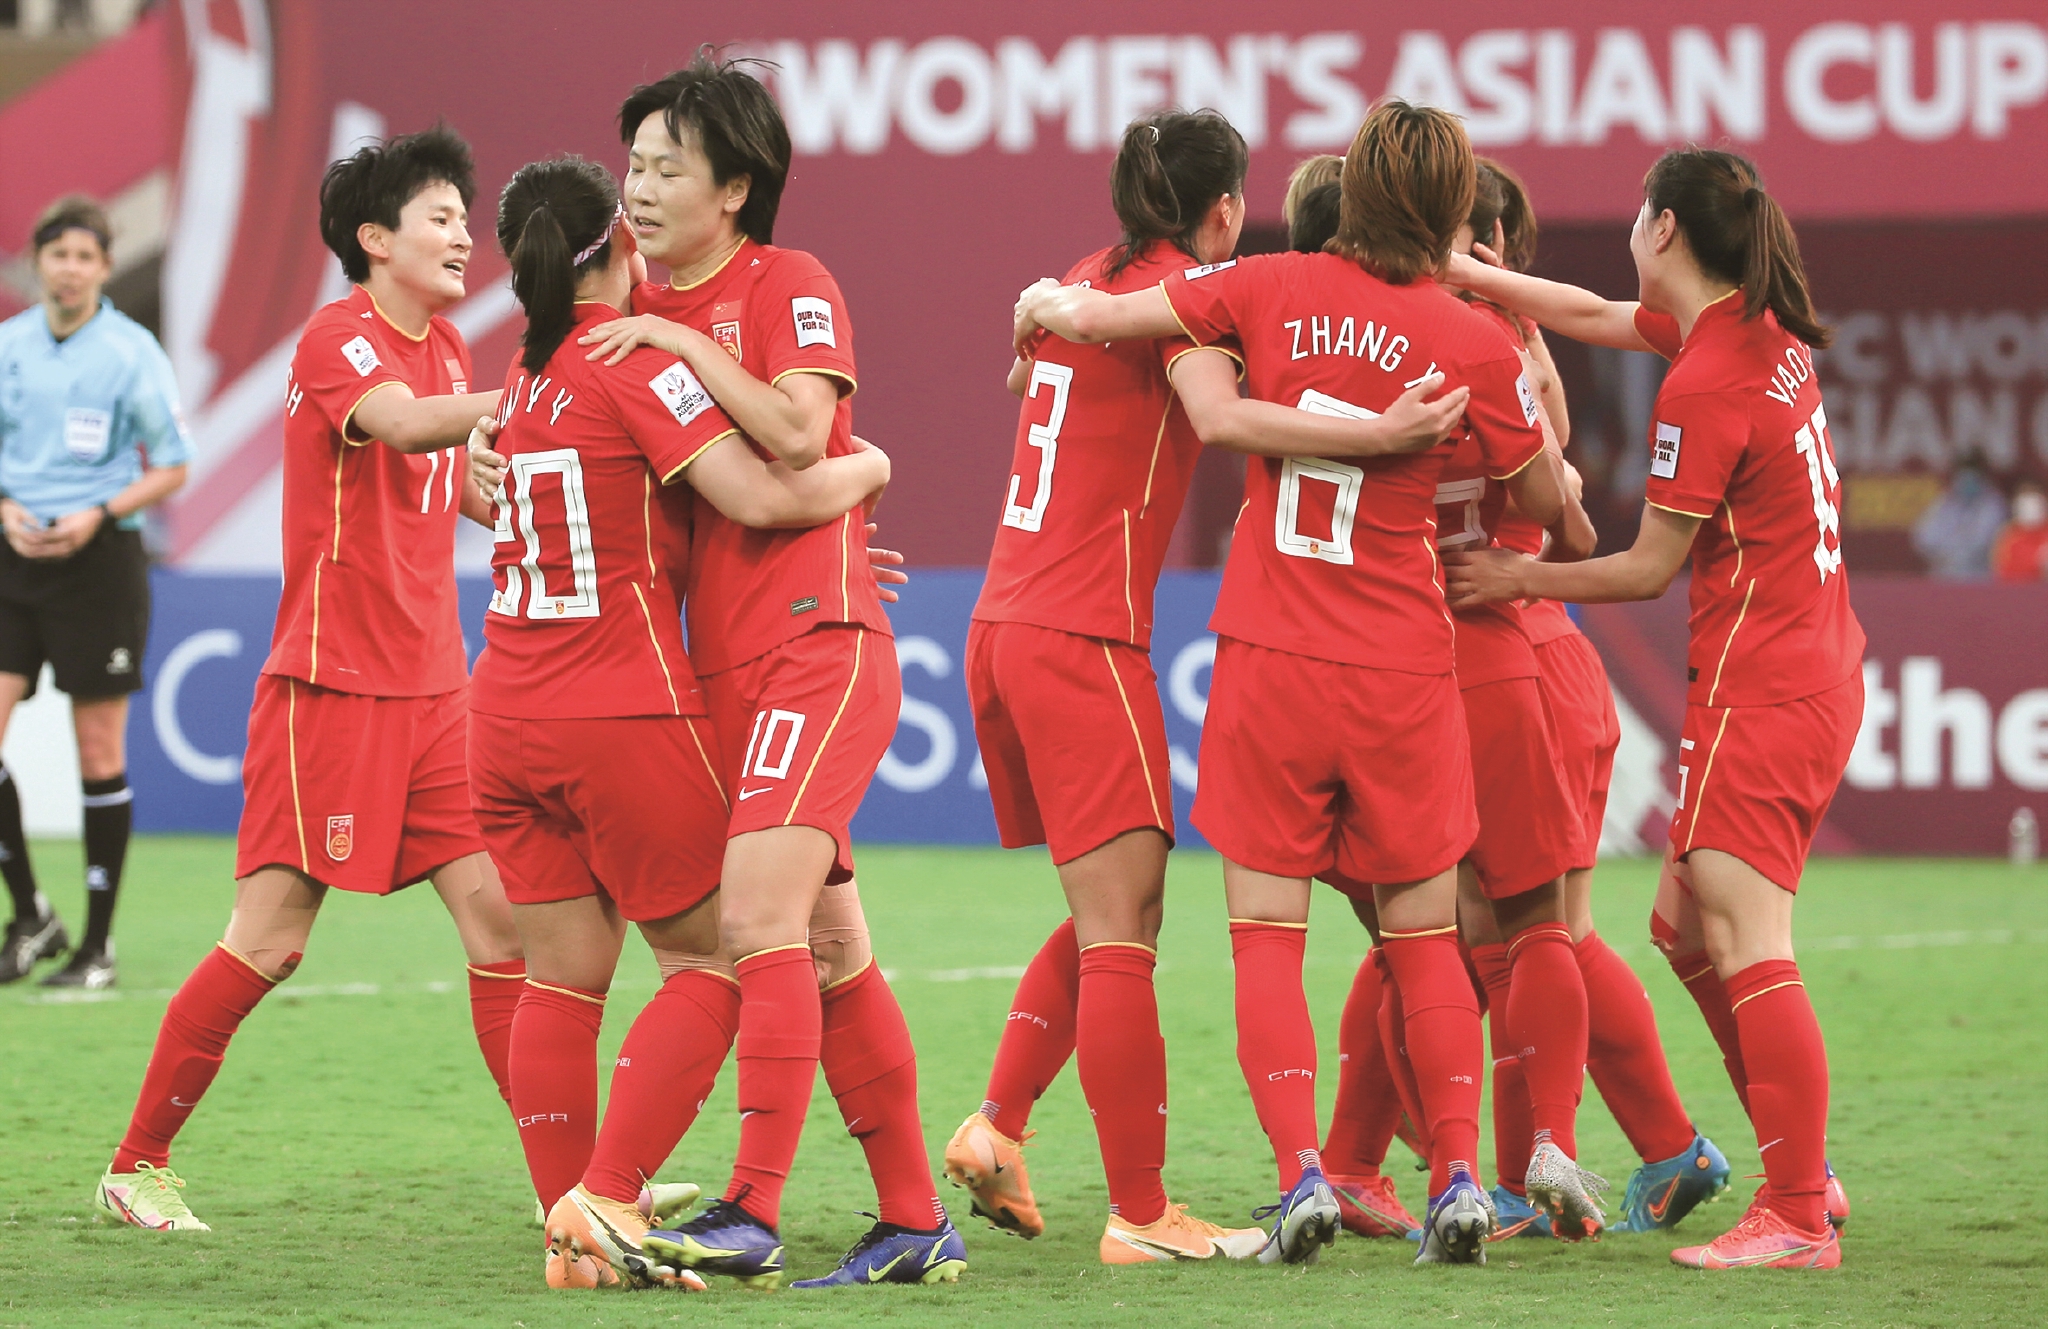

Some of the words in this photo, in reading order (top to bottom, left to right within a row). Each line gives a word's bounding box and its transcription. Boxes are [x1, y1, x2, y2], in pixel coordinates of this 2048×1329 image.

[774, 33, 1366, 155] WOMEN'S
[1384, 27, 1768, 146] ASIAN
[1783, 21, 2048, 143] CUP
[1283, 315, 1411, 373] ZHANG
[1900, 312, 2048, 380] WO
[420, 446, 456, 514] 11
[1002, 359, 1074, 533] 3
[741, 708, 806, 780] 10
[1844, 655, 2048, 791] the
[1268, 1068, 1313, 1082] CFA
[518, 1113, 568, 1128] CFA
